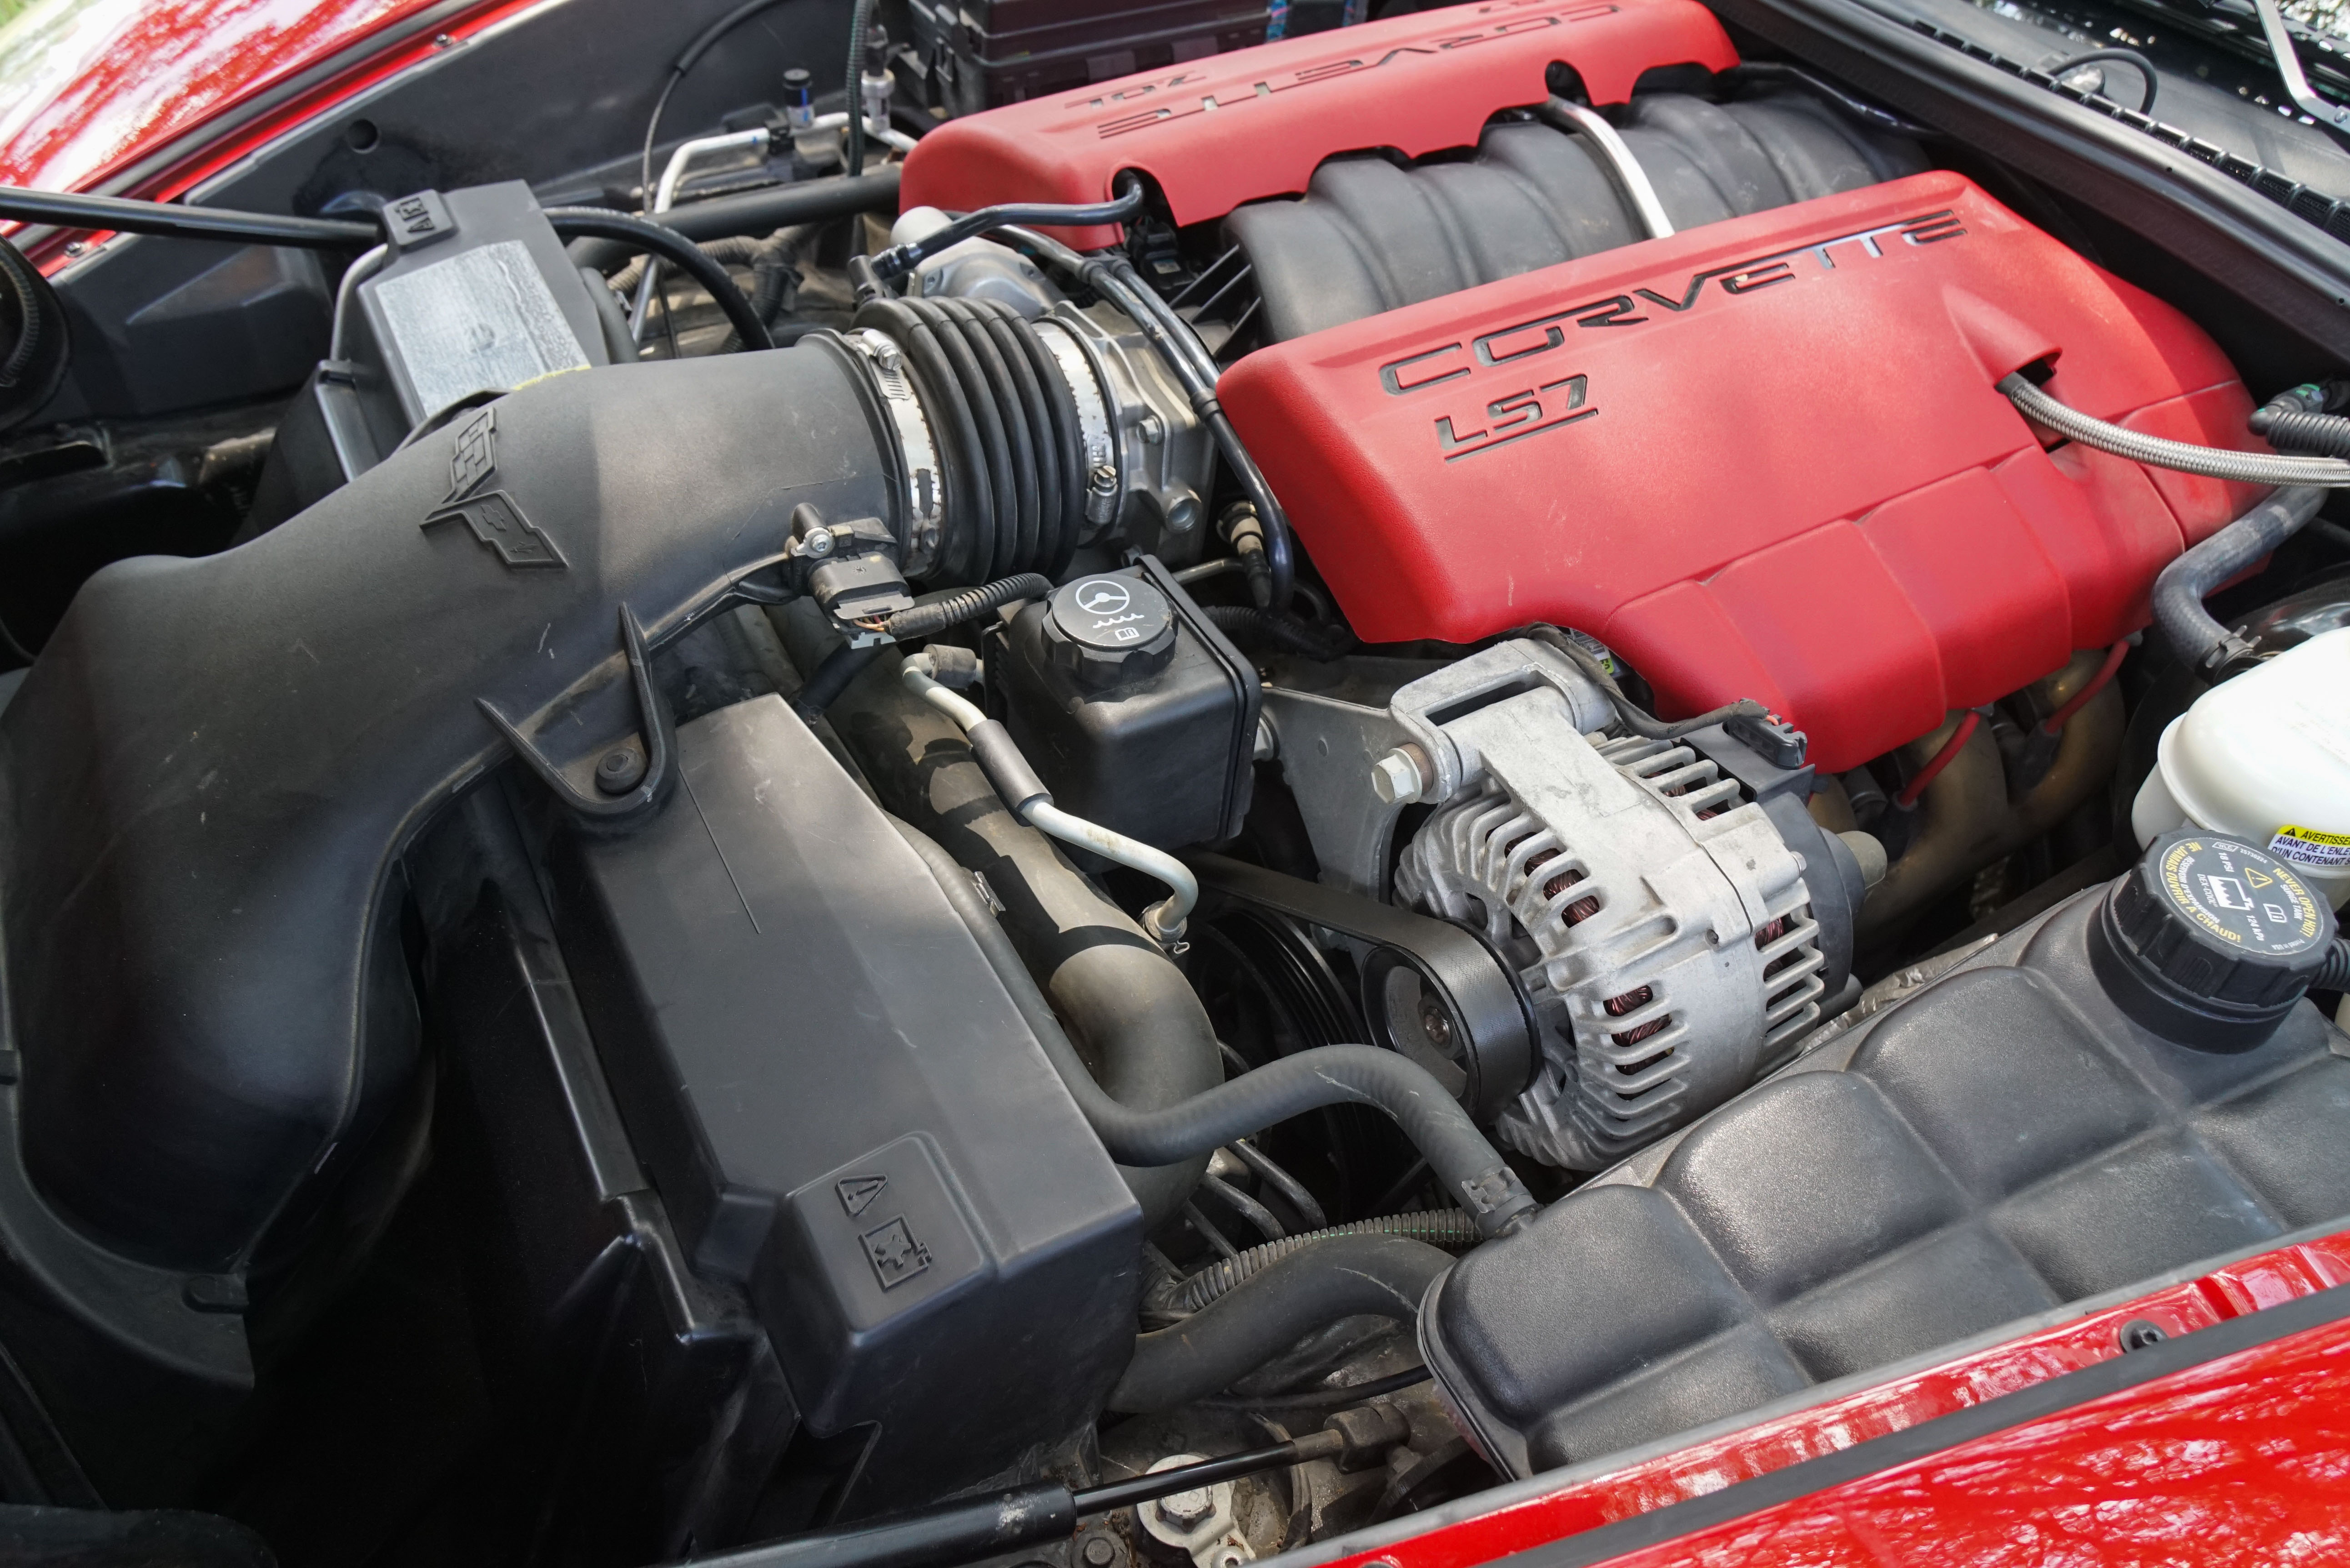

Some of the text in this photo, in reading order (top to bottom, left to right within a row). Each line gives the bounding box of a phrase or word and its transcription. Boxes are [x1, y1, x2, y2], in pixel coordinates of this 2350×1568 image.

[1097, 4, 1622, 139] CORVETTE
[1378, 210, 1968, 396] CORVETTE
[1434, 373, 1588, 451] LS7
[2185, 841, 2203, 852] NE
[2275, 836, 2350, 855] AVANT DE L'ENLE
[2300, 830, 2350, 845] AVERTISSE
[2165, 845, 2189, 873] JAMAIS
[2219, 852, 2235, 872] 18 PSI
[2240, 849, 2268, 864] 25730224
[2292, 851, 2346, 865] CONTENANT
[2166, 872, 2190, 904] OUVRIR
[2280, 884, 2303, 921] SURGE TANK
[2180, 884, 2220, 924] D'EXPANSION
[2273, 868, 2317, 938] NEVER OPEN HOT!
[2196, 913, 2241, 943] CHAUD!
[2246, 915, 2260, 927] 124
